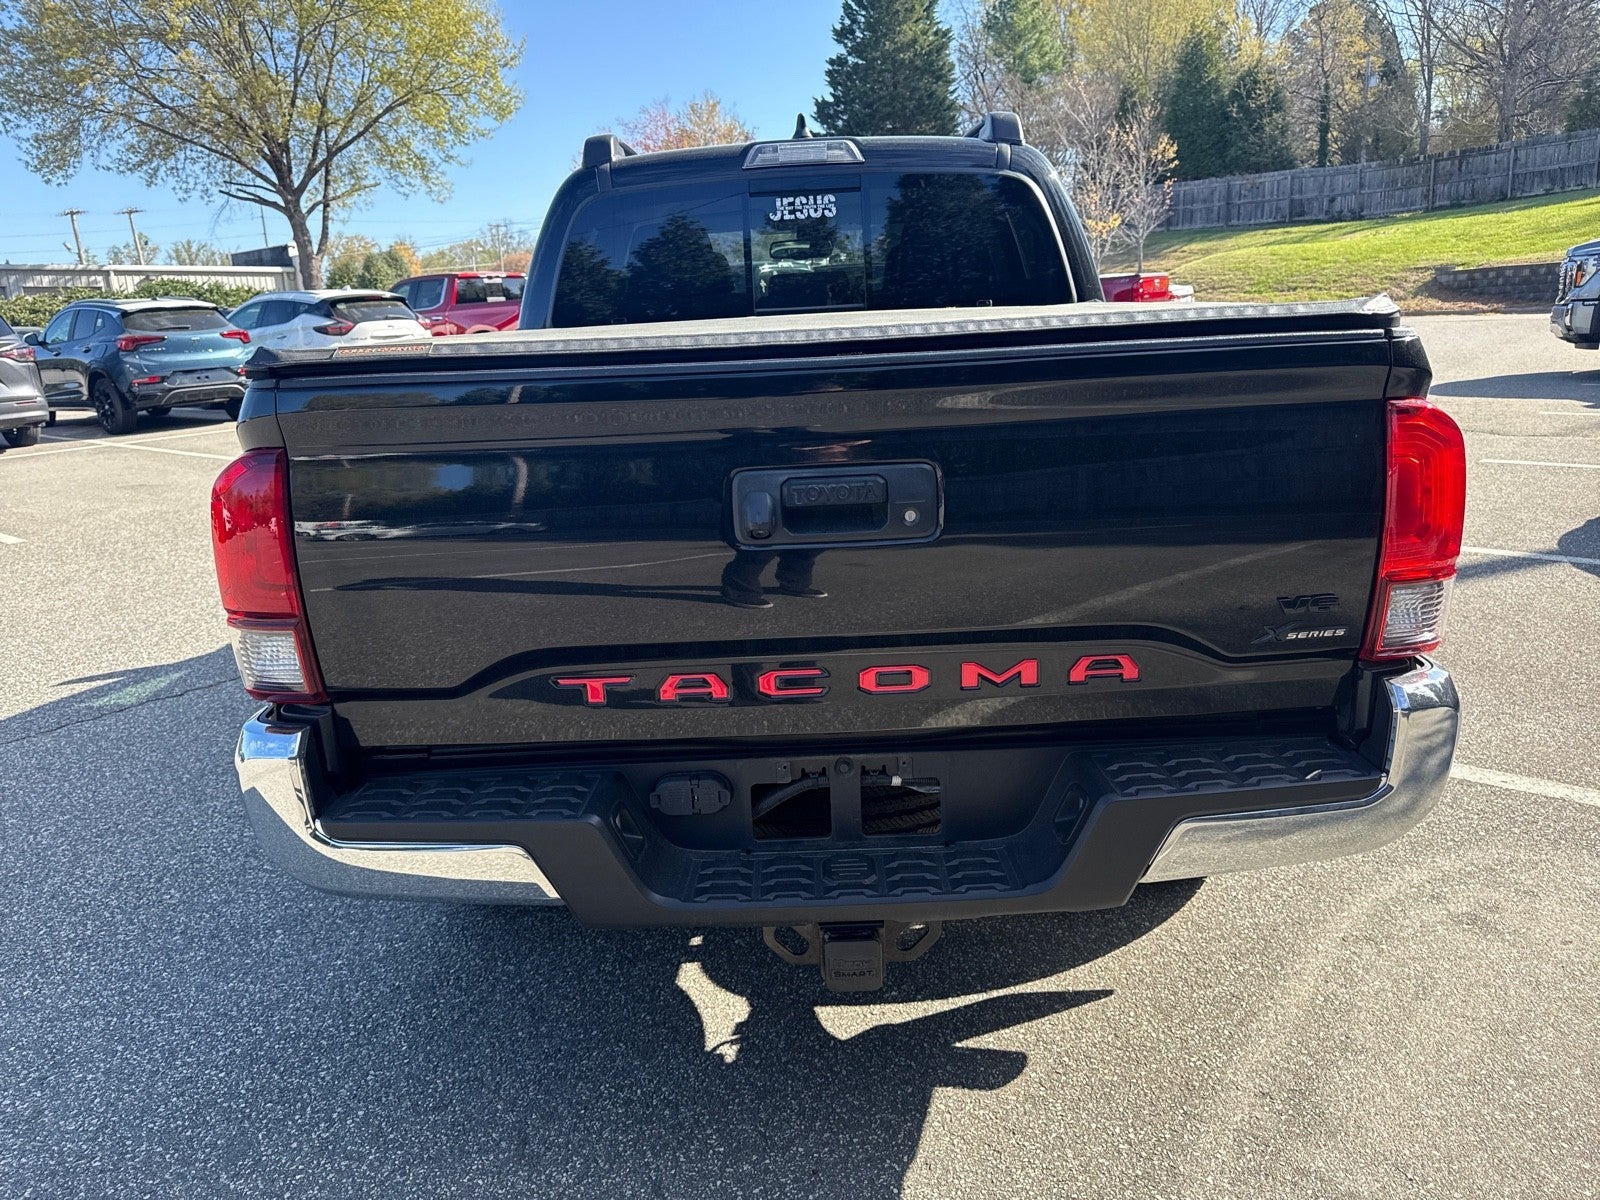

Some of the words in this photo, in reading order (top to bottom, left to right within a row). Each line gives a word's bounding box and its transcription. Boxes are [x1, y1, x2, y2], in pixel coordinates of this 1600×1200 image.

[769, 194, 837, 221] JESUS
[791, 483, 877, 505] TOYOTA
[1286, 628, 1347, 640] SERIES
[553, 653, 1142, 704] TACOMA
